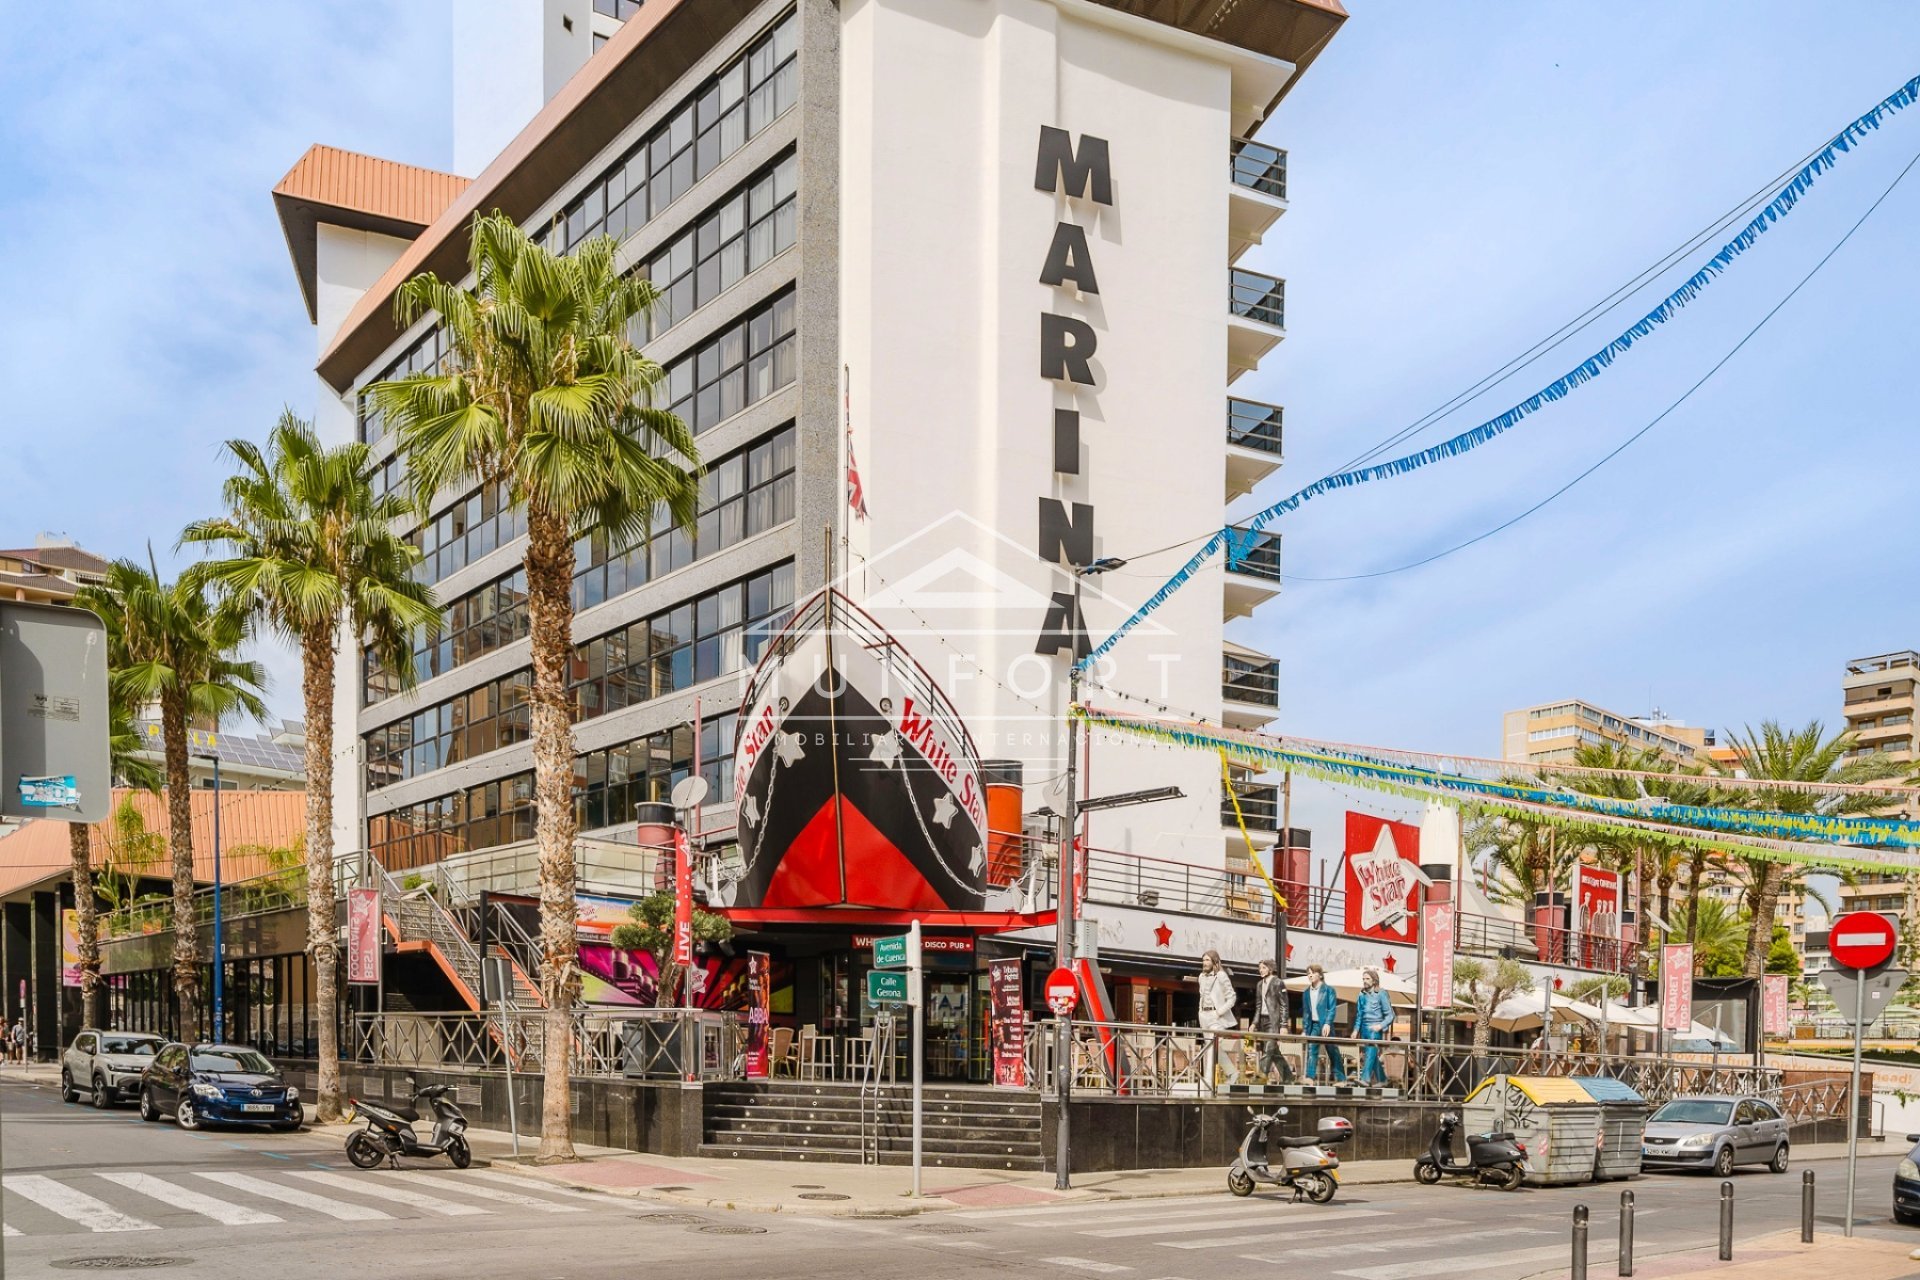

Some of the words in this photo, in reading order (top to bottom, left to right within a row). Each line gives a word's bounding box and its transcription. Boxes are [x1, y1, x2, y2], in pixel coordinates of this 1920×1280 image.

[1035, 125, 1112, 660] MARINA
[744, 705, 774, 768] Star
[900, 696, 958, 784] White
[1358, 860, 1401, 888] White
[1370, 877, 1406, 912] Star
[678, 921, 690, 961] LIVE
[880, 942, 903, 952] Avenida
[924, 941, 947, 949] DISCO
[949, 941, 965, 949] PUB
[876, 955, 884, 963] de
[884, 953, 906, 962] Cuenca
[1441, 940, 1453, 1006] TRIBUTES
[876, 987, 901, 997] Gerona
[880, 977, 897, 986] Calle
[1427, 970, 1439, 1006] BEST
[1681, 972, 1691, 1004] ACTS
[748, 1007, 769, 1024] ABBA
[1667, 974, 1679, 1026] CABARET
[1680, 1004, 1690, 1026] TOP
[1775, 994, 1786, 1034] SPORTS
[1765, 1010, 1774, 1030] LIVE
